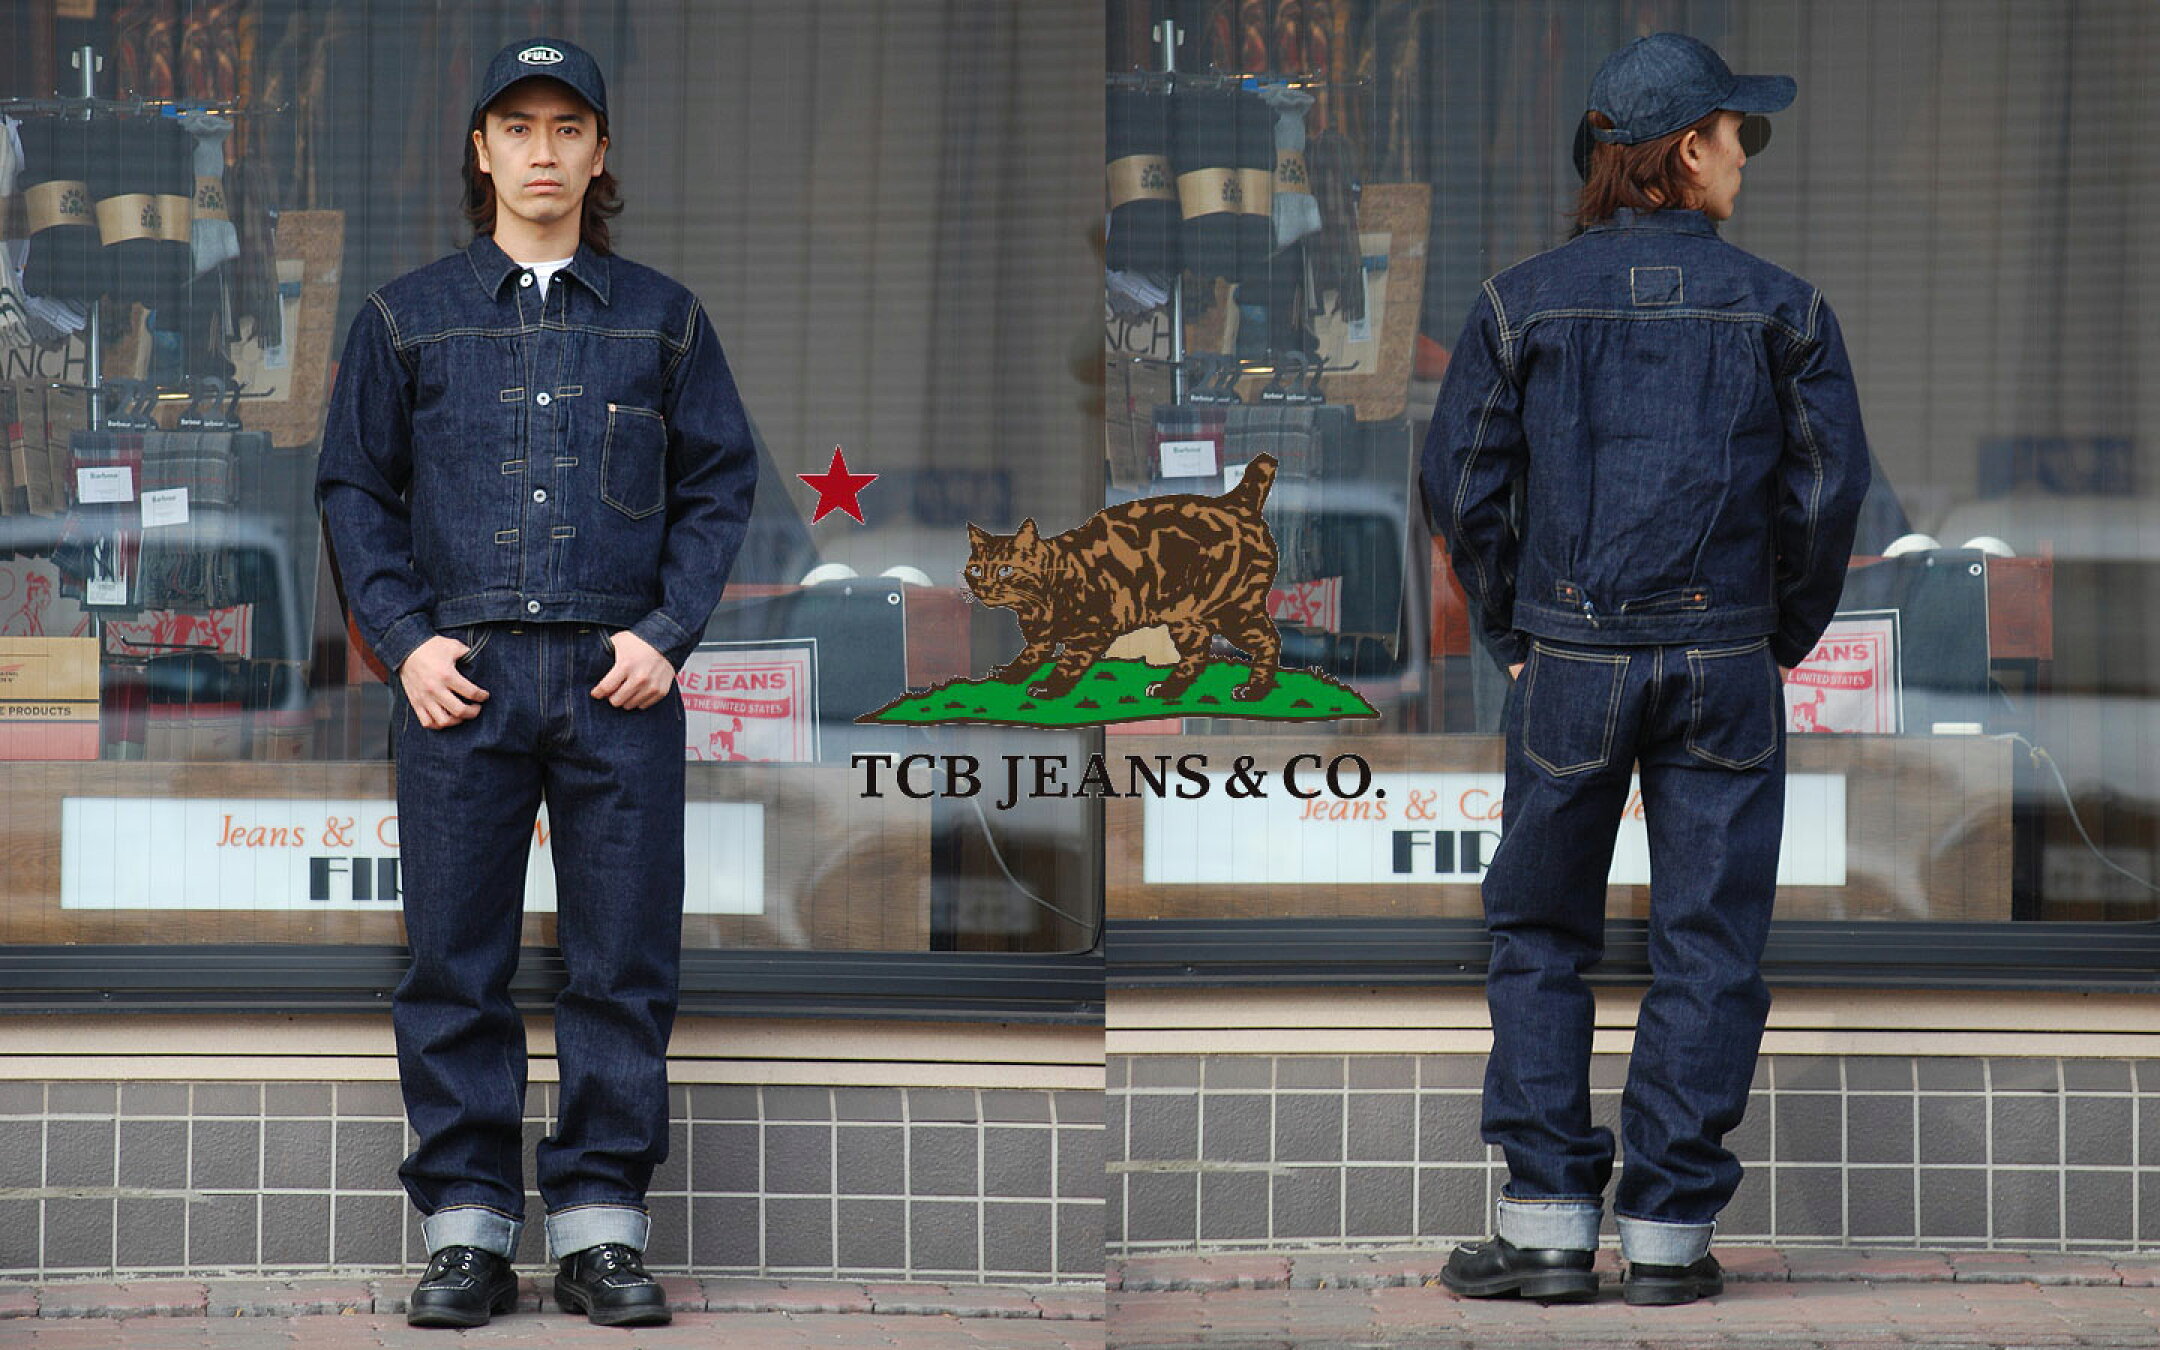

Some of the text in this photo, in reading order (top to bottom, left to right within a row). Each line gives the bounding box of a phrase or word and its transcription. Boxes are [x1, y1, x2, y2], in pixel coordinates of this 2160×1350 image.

[704, 672, 787, 692] JEANS
[1830, 673, 1866, 686] STATES
[8, 706, 72, 717] PRODUCTS
[748, 703, 784, 715] STATES
[1404, 788, 1438, 821] &
[216, 813, 305, 848] Jeans
[321, 815, 355, 848] &
